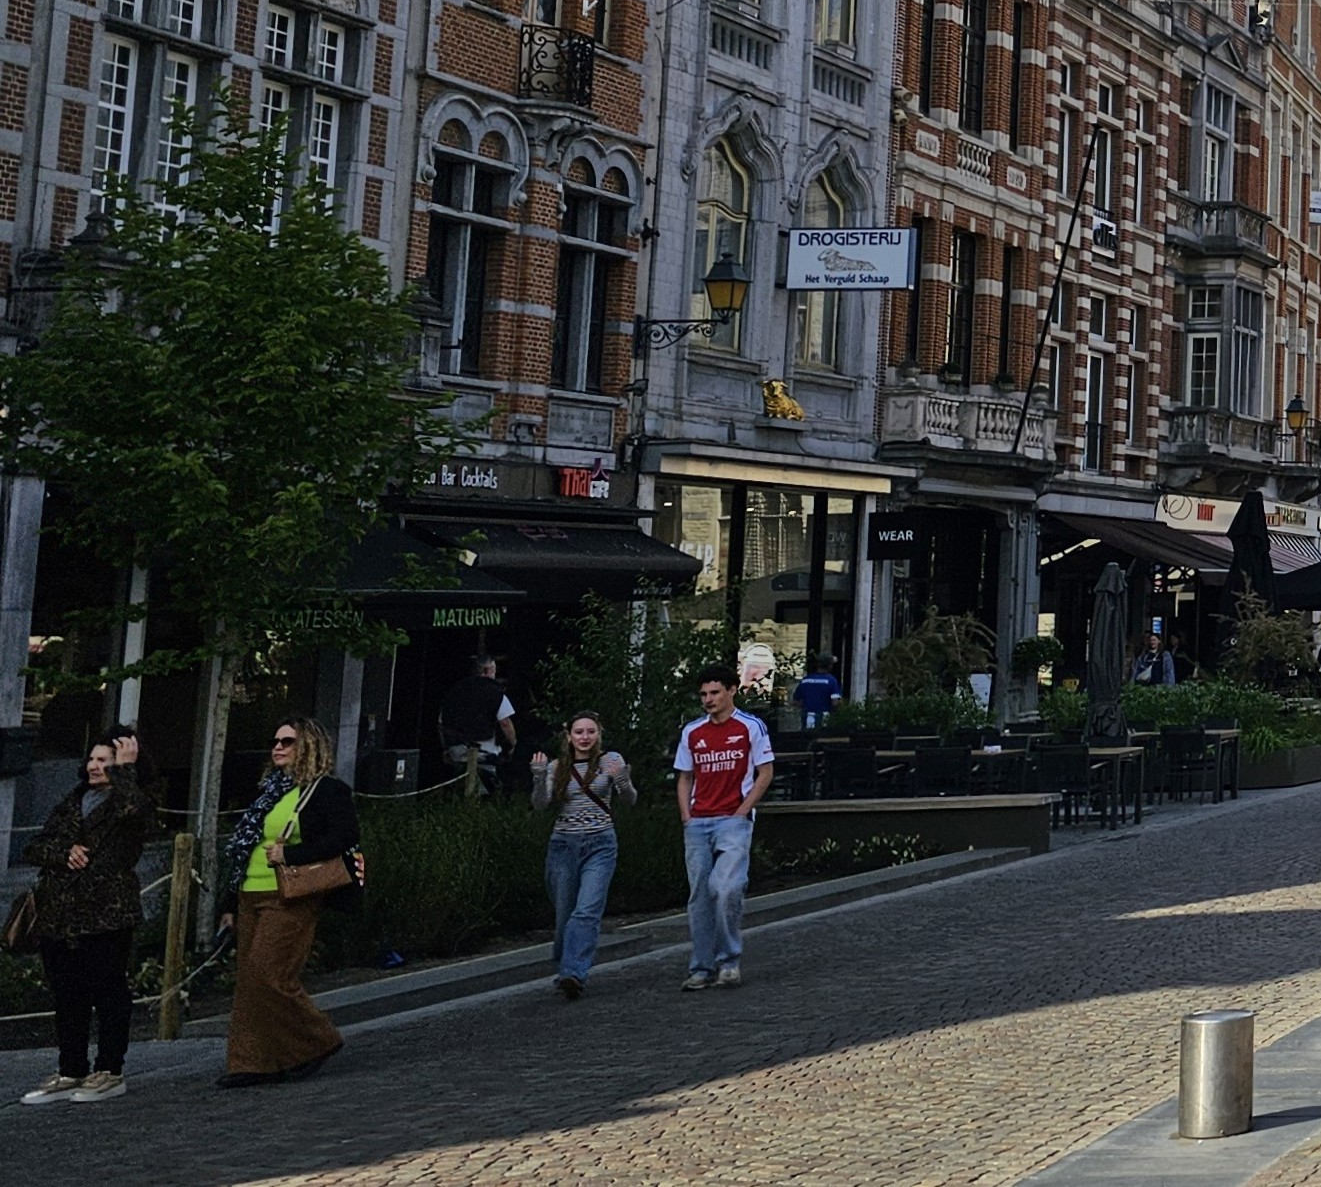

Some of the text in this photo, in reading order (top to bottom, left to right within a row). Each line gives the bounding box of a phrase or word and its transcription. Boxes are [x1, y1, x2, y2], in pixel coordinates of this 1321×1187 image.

[798, 232, 901, 246] DROGISTERIJ
[805, 274, 889, 286] Het Verguld Schaap
[441, 464, 456, 486] Bar
[461, 465, 498, 490] Cocktails
[562, 468, 592, 498] Thai
[879, 530, 914, 541] WEAR
[694, 749, 744, 764] Emirates
[711, 760, 736, 772] BETTER
